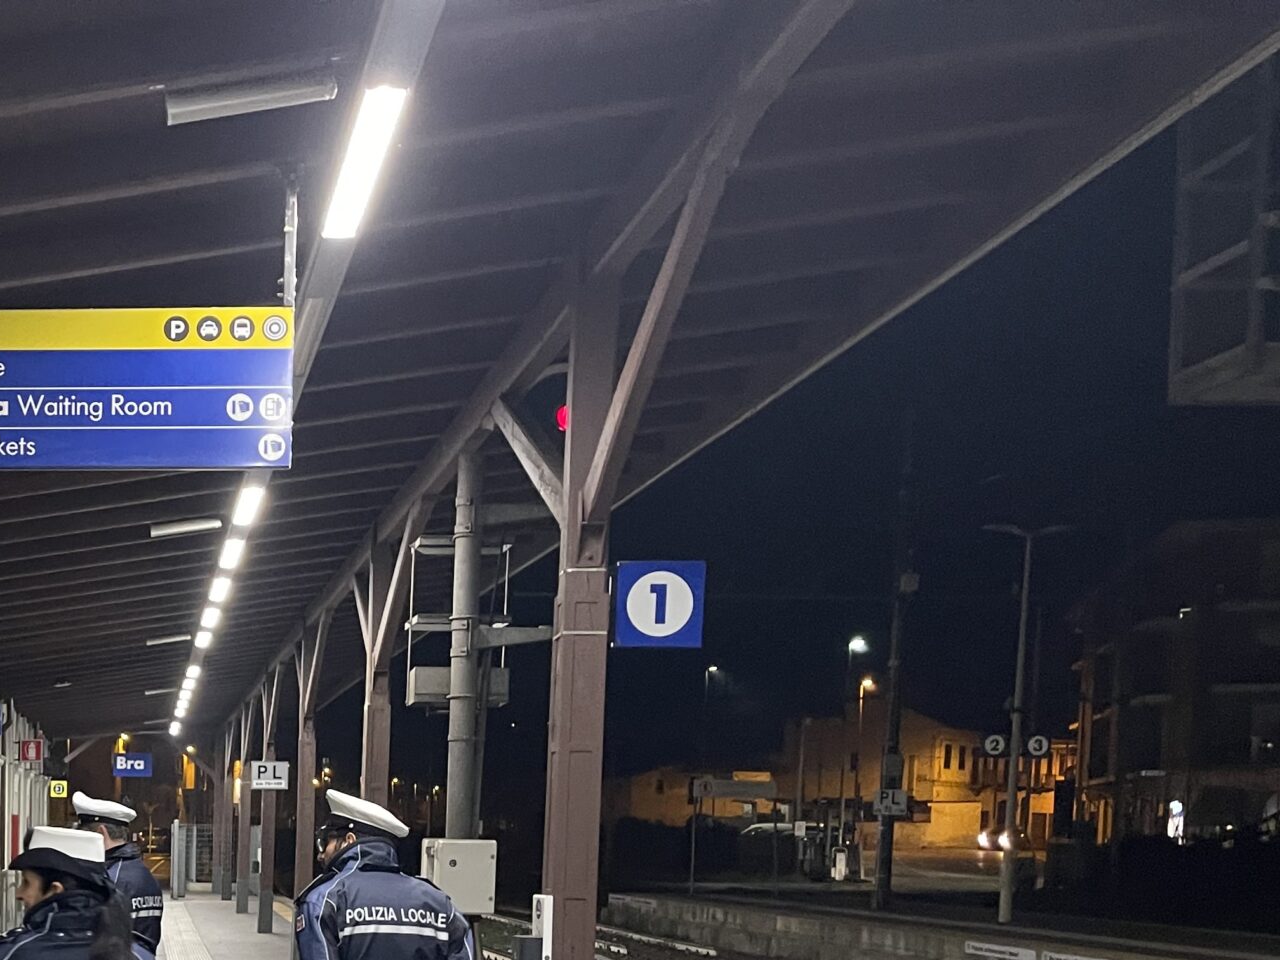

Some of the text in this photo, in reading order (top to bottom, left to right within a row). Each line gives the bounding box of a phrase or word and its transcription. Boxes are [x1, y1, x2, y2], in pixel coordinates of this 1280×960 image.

[17, 394, 103, 422] Waiting
[111, 394, 173, 416] Room
[650, 583, 667, 625] 1
[990, 739, 1000, 751] 2
[1033, 738, 1043, 751] 3
[116, 756, 145, 770] Bra
[345, 906, 447, 928] POLIZIA LOCALE
